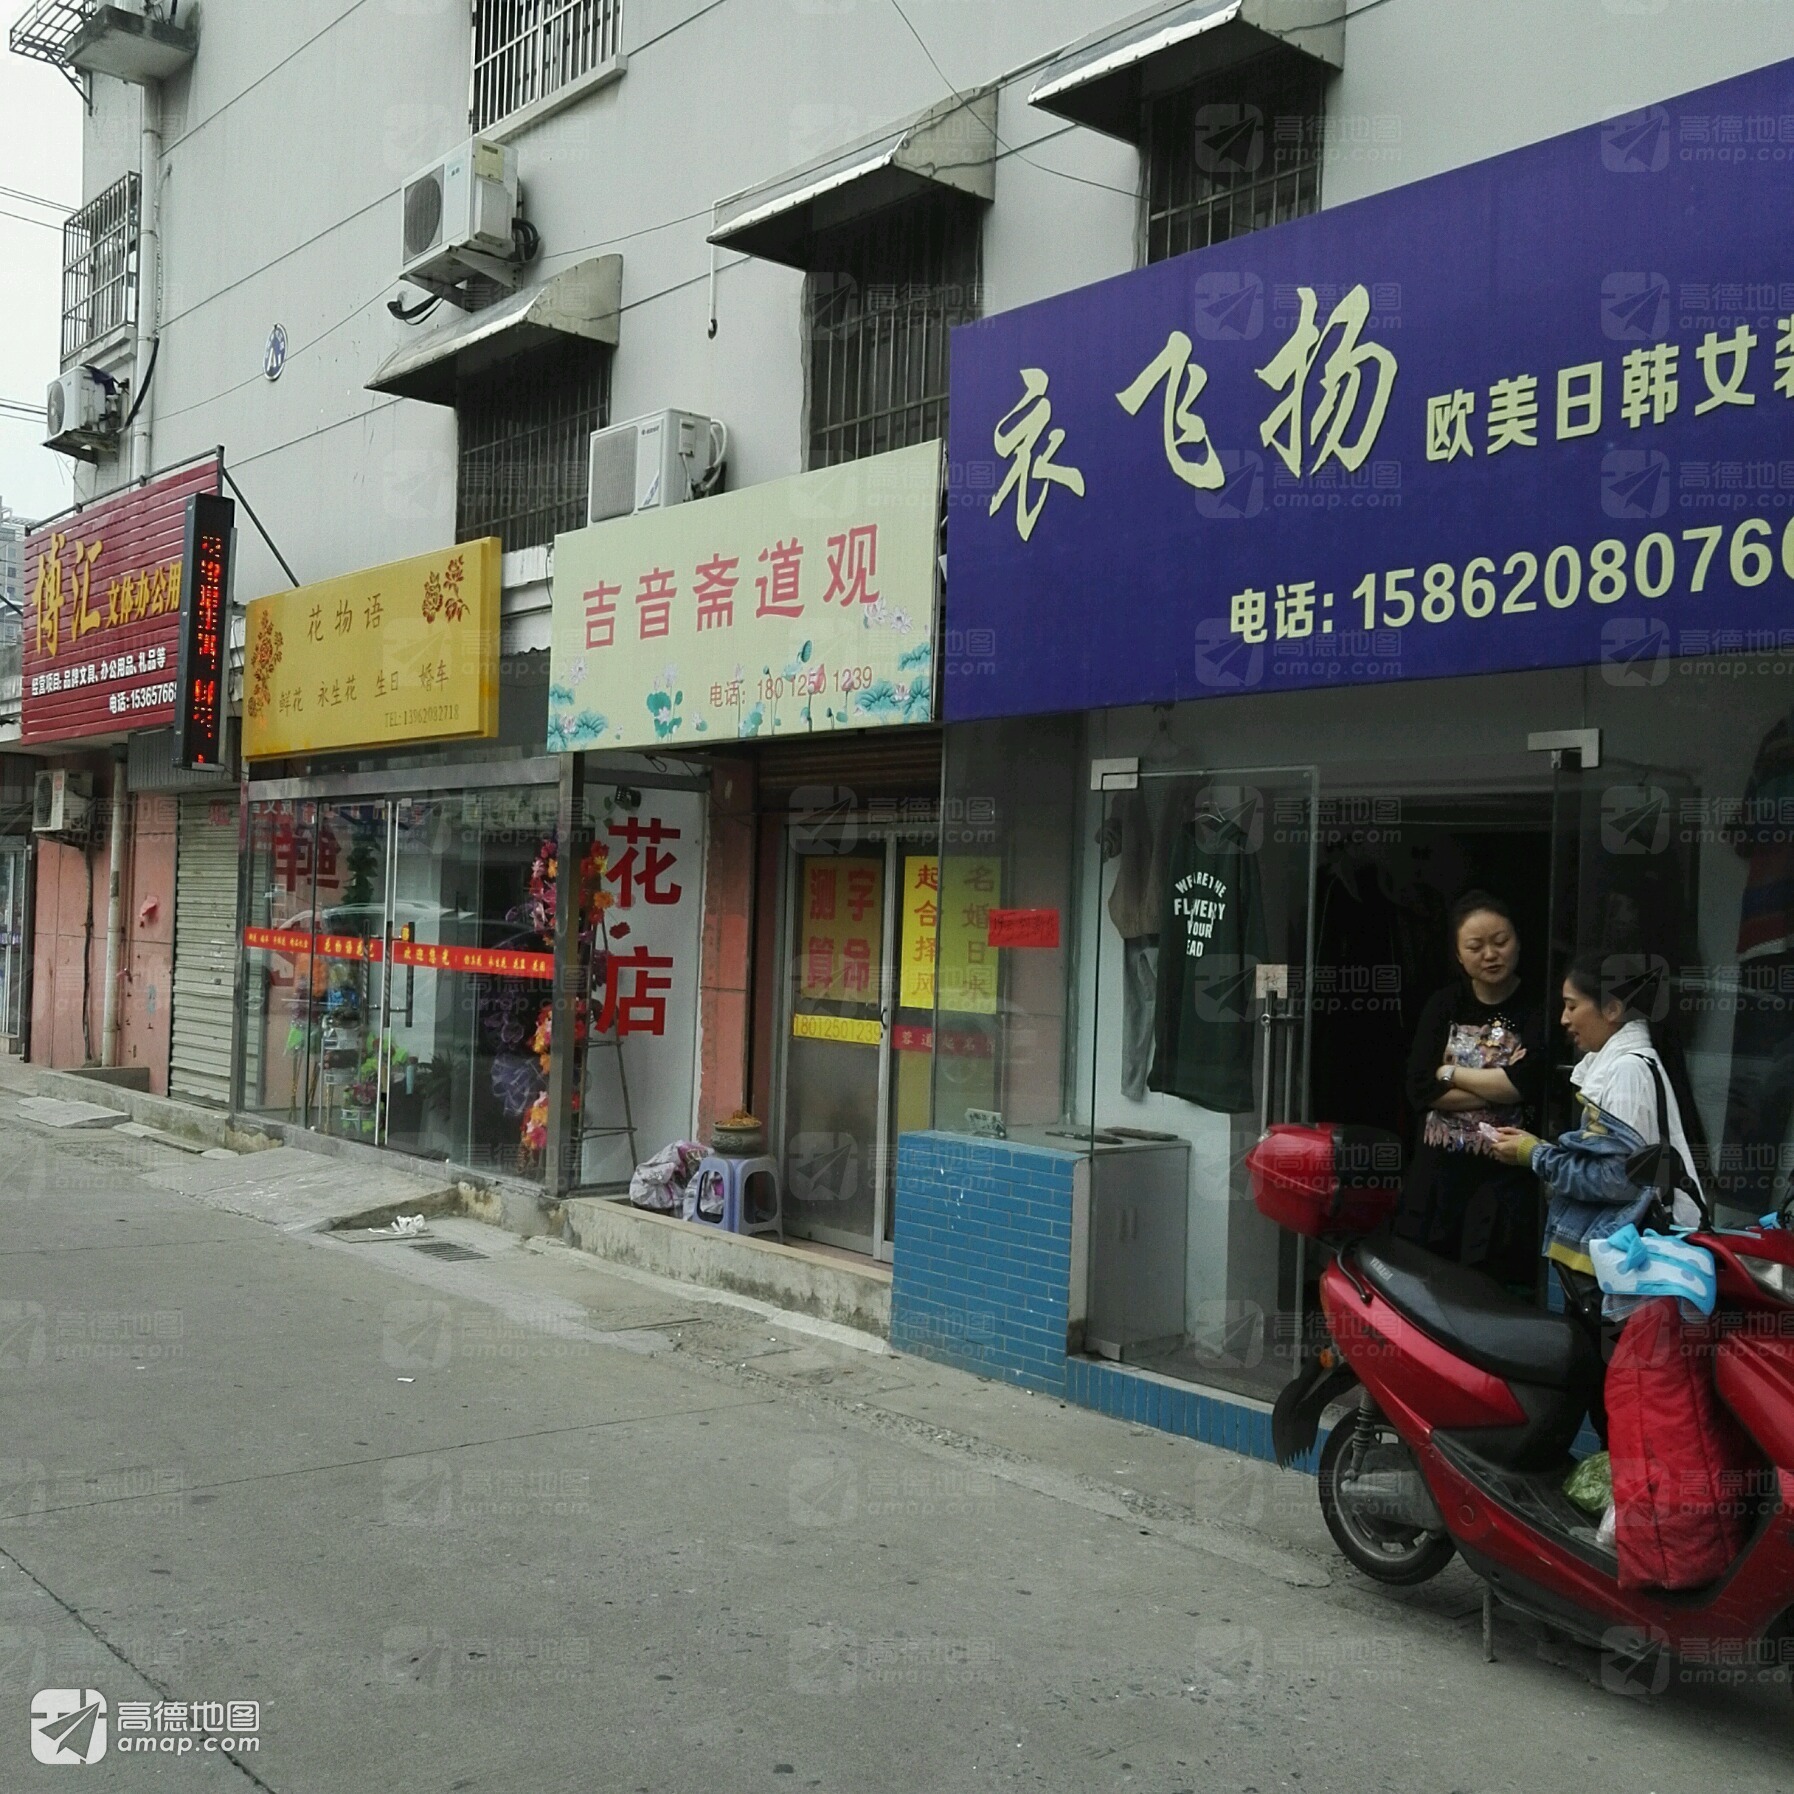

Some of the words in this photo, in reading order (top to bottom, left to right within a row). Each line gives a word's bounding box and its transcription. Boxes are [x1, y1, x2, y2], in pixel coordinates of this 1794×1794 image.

[990, 283, 1398, 541] 衣飞扬
[307, 593, 383, 642] 花物语
[583, 523, 880, 650] 吉音斋道观
[278, 687, 304, 716] 鲜花
[317, 674, 357, 707] 永生花
[375, 669, 399, 698] 生日
[419, 660, 450, 692] 婚车
